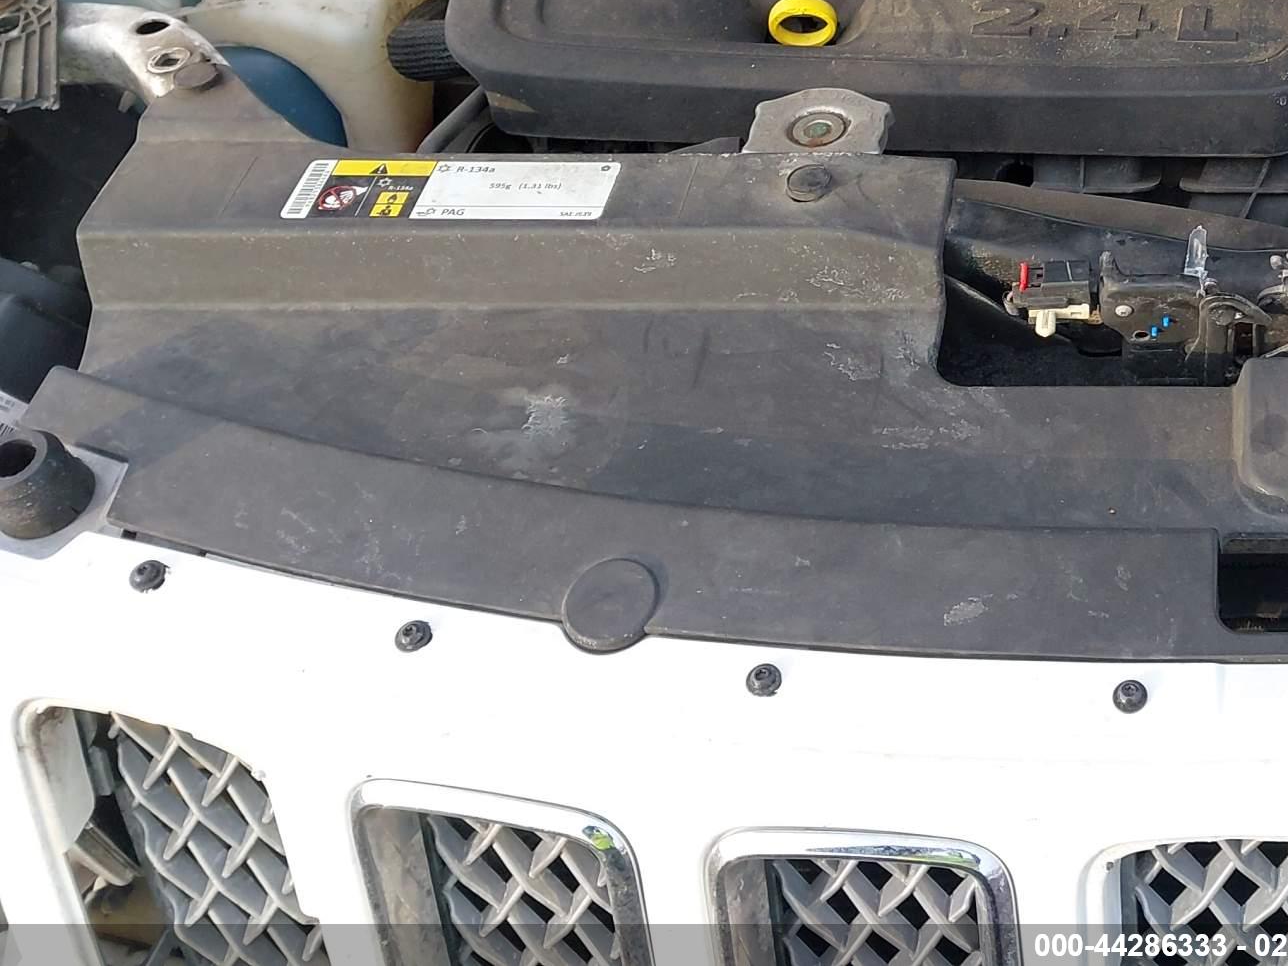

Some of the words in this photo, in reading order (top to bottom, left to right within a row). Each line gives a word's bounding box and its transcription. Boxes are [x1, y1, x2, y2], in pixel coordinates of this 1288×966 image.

[970, 0, 1240, 43] 2.4L
[456, 165, 496, 173] R-134a
[441, 208, 465, 216] PAG
